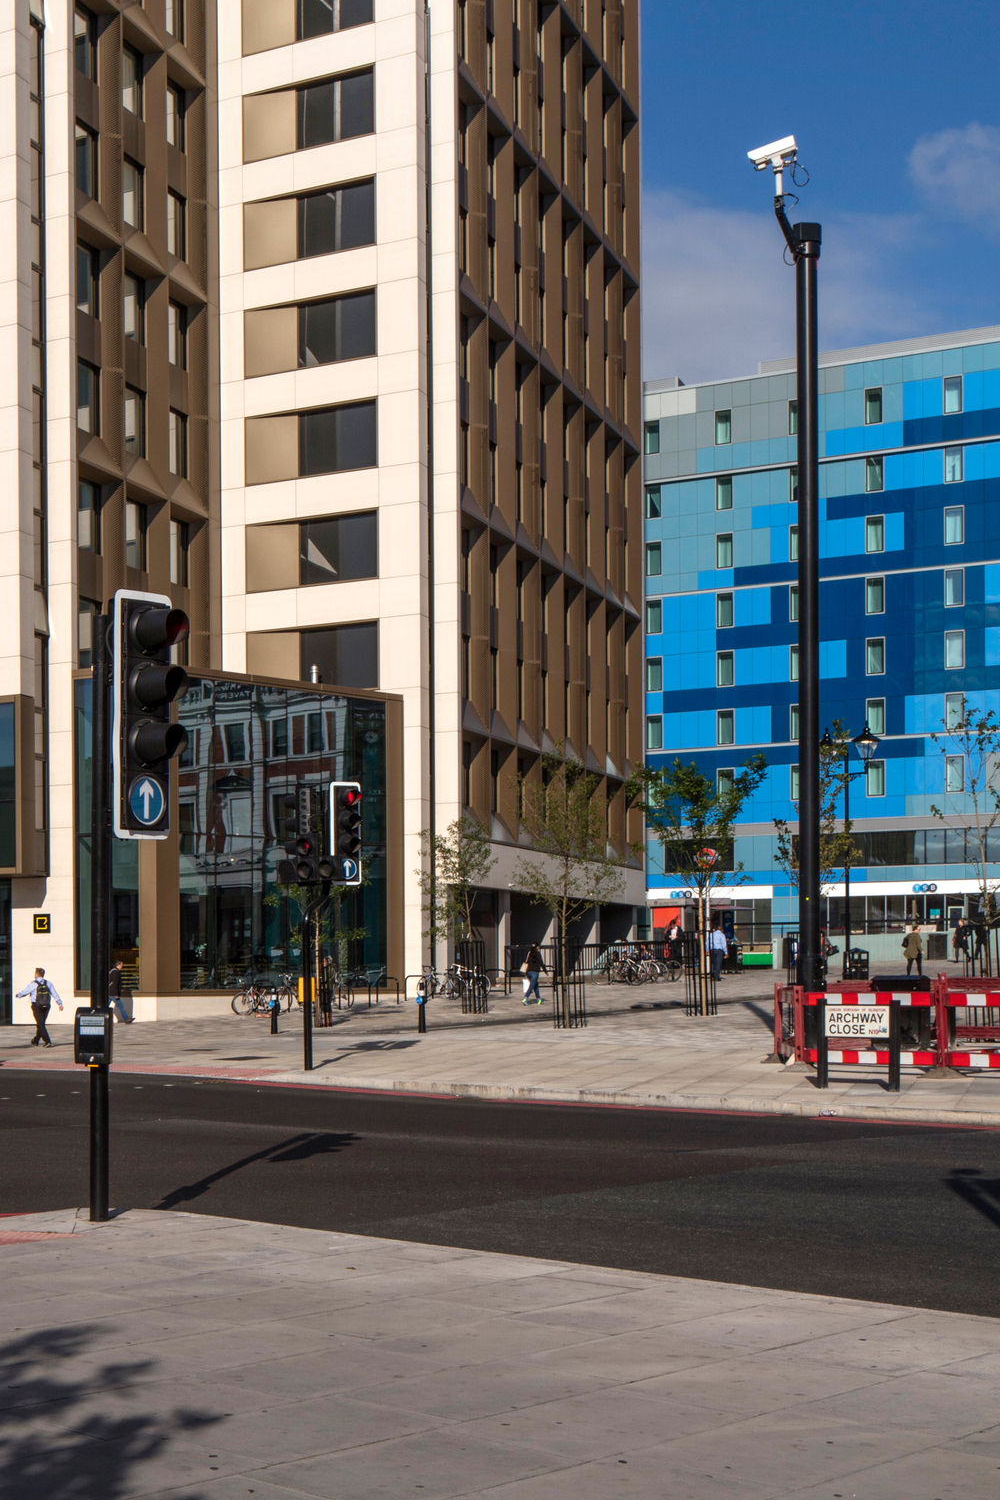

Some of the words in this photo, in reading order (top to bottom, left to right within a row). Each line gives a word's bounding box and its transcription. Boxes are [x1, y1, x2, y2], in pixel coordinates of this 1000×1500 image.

[913, 884, 937, 892] TSB
[829, 1013, 884, 1023] ARCHWAY
[829, 1024, 865, 1034] CLOSE
